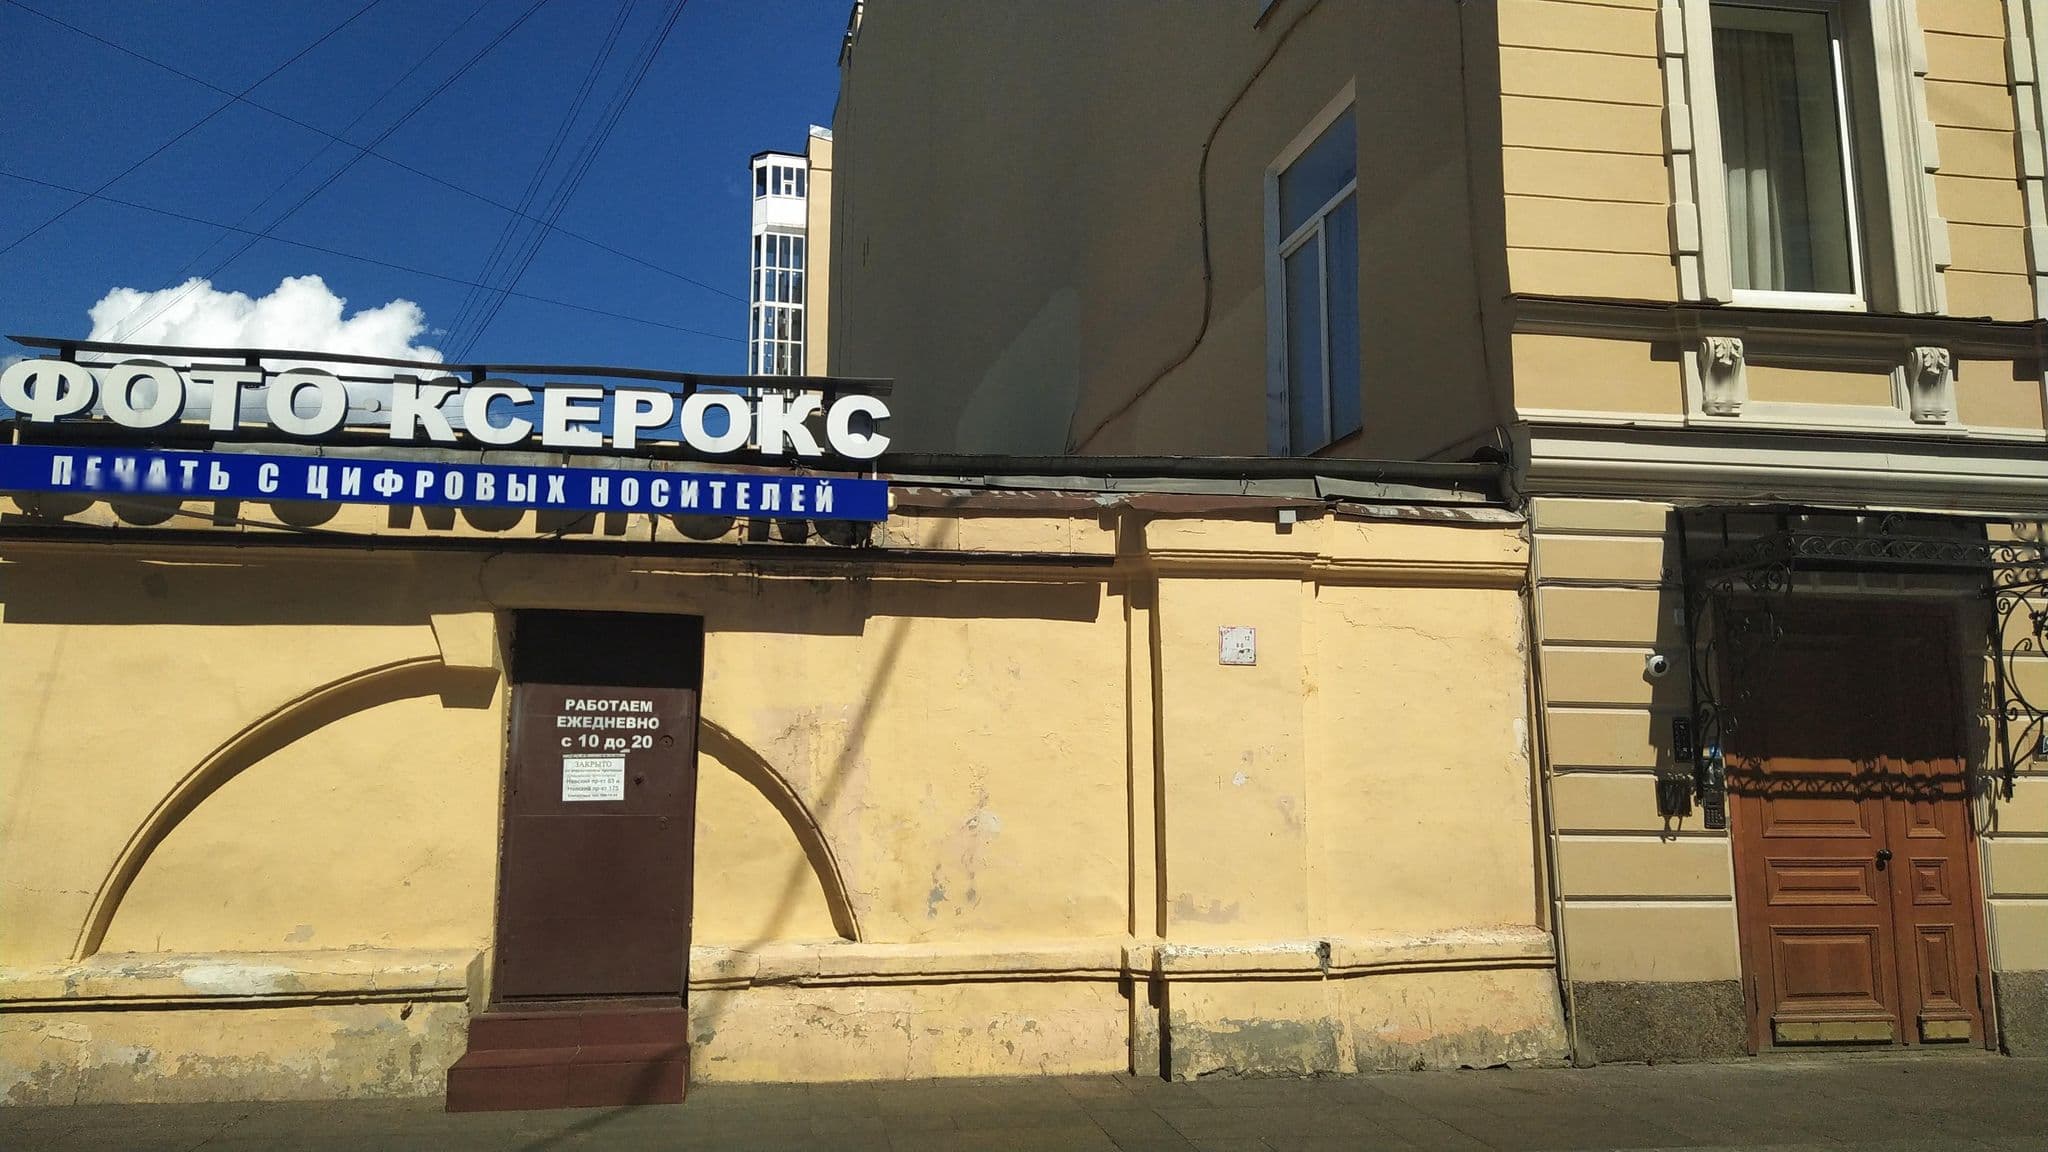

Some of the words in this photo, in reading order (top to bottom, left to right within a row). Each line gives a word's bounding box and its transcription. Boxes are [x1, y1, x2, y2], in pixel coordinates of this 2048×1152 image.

[0, 358, 349, 436] ФОТО
[390, 376, 891, 459] КСЕРОКС
[51, 454, 231, 492] ПЕЧАТЬ
[258, 462, 280, 493] С
[307, 464, 566, 503] ЦИФРОВЫХ
[590, 475, 835, 513] НОСИТЕЛЕЙ
[565, 699, 653, 712] РАБОТАЕМ
[556, 715, 660, 730] ЕЖЕДНЕВНО
[578, 734, 599, 748] 10
[603, 737, 626, 750] до
[631, 735, 653, 748] 20
